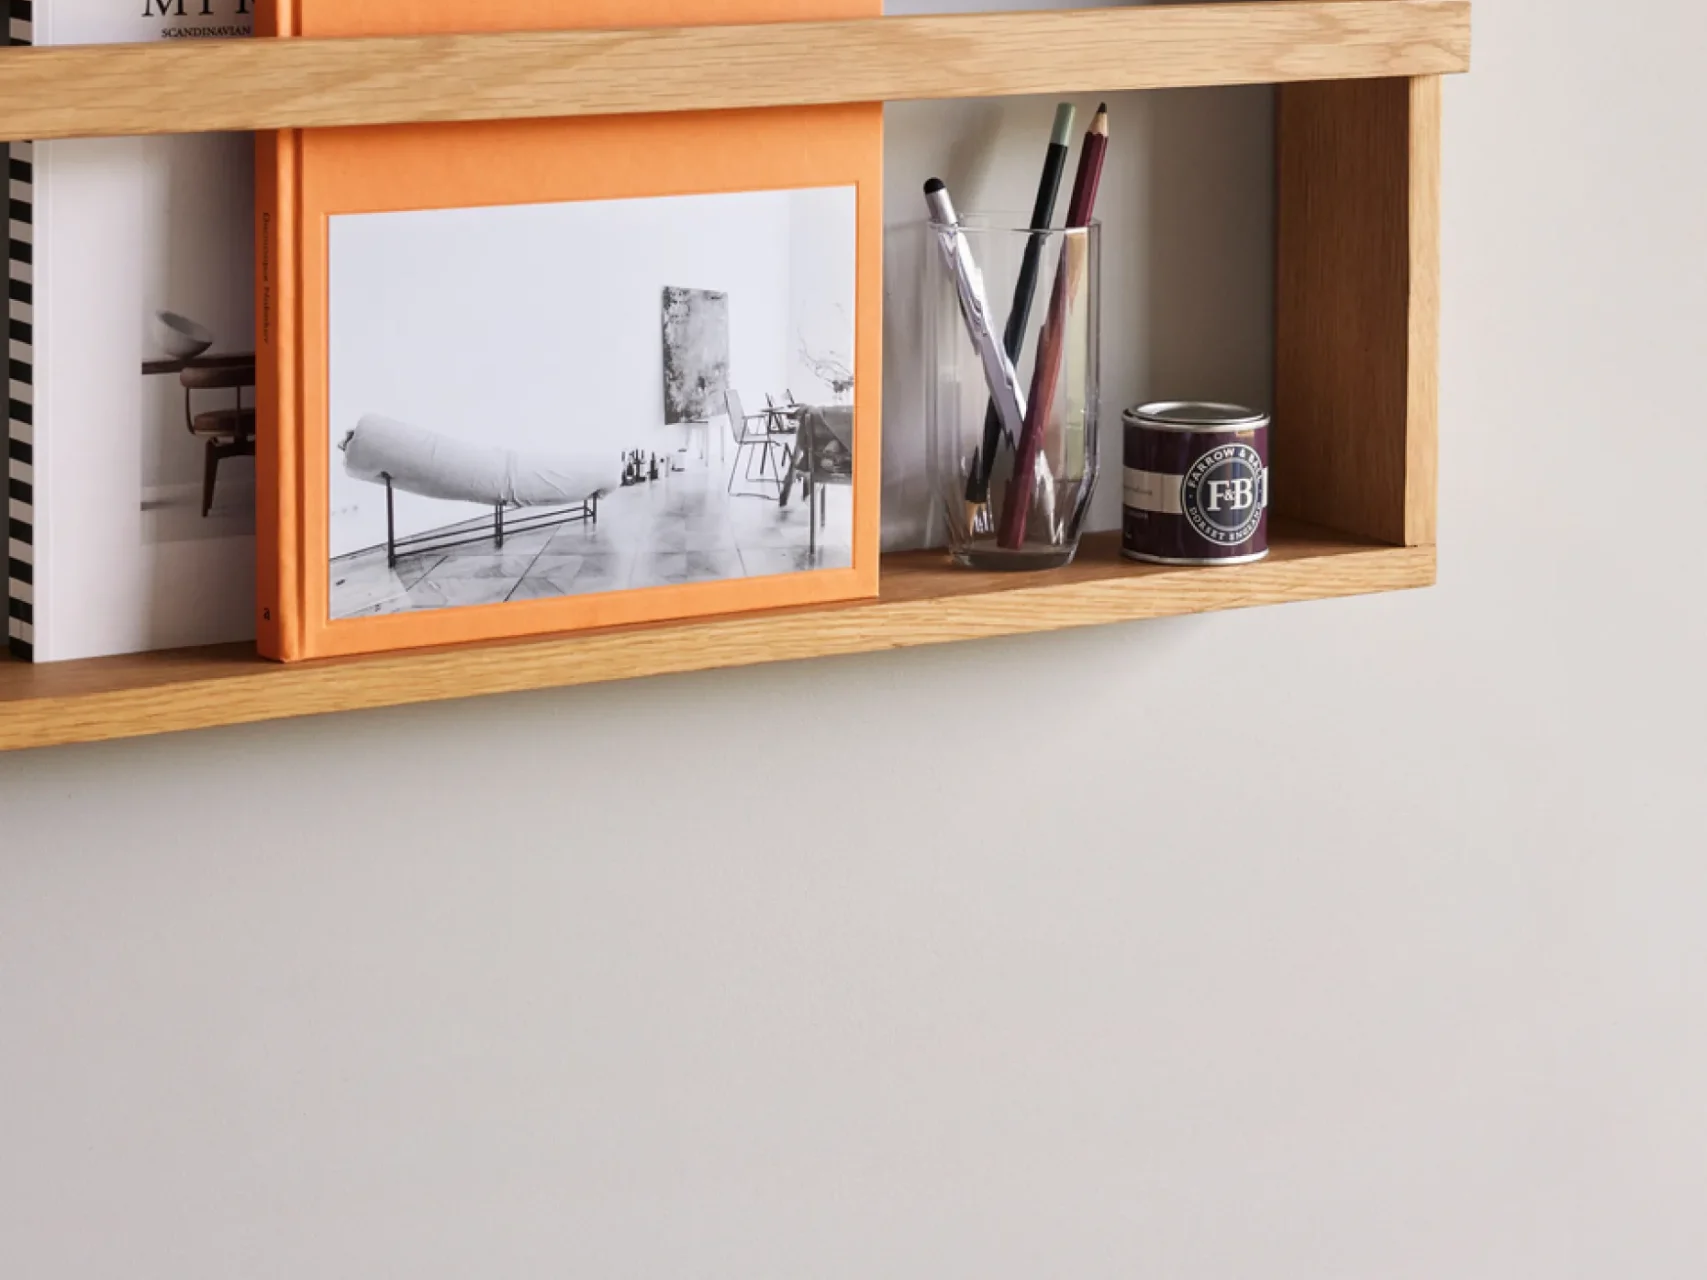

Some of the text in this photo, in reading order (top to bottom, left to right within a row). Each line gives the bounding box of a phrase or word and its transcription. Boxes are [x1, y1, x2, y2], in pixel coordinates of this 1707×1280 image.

[161, 25, 251, 38] SCANDINAVIAN
[1187, 447, 1235, 489] FARROW
[1207, 479, 1253, 511] F&B
